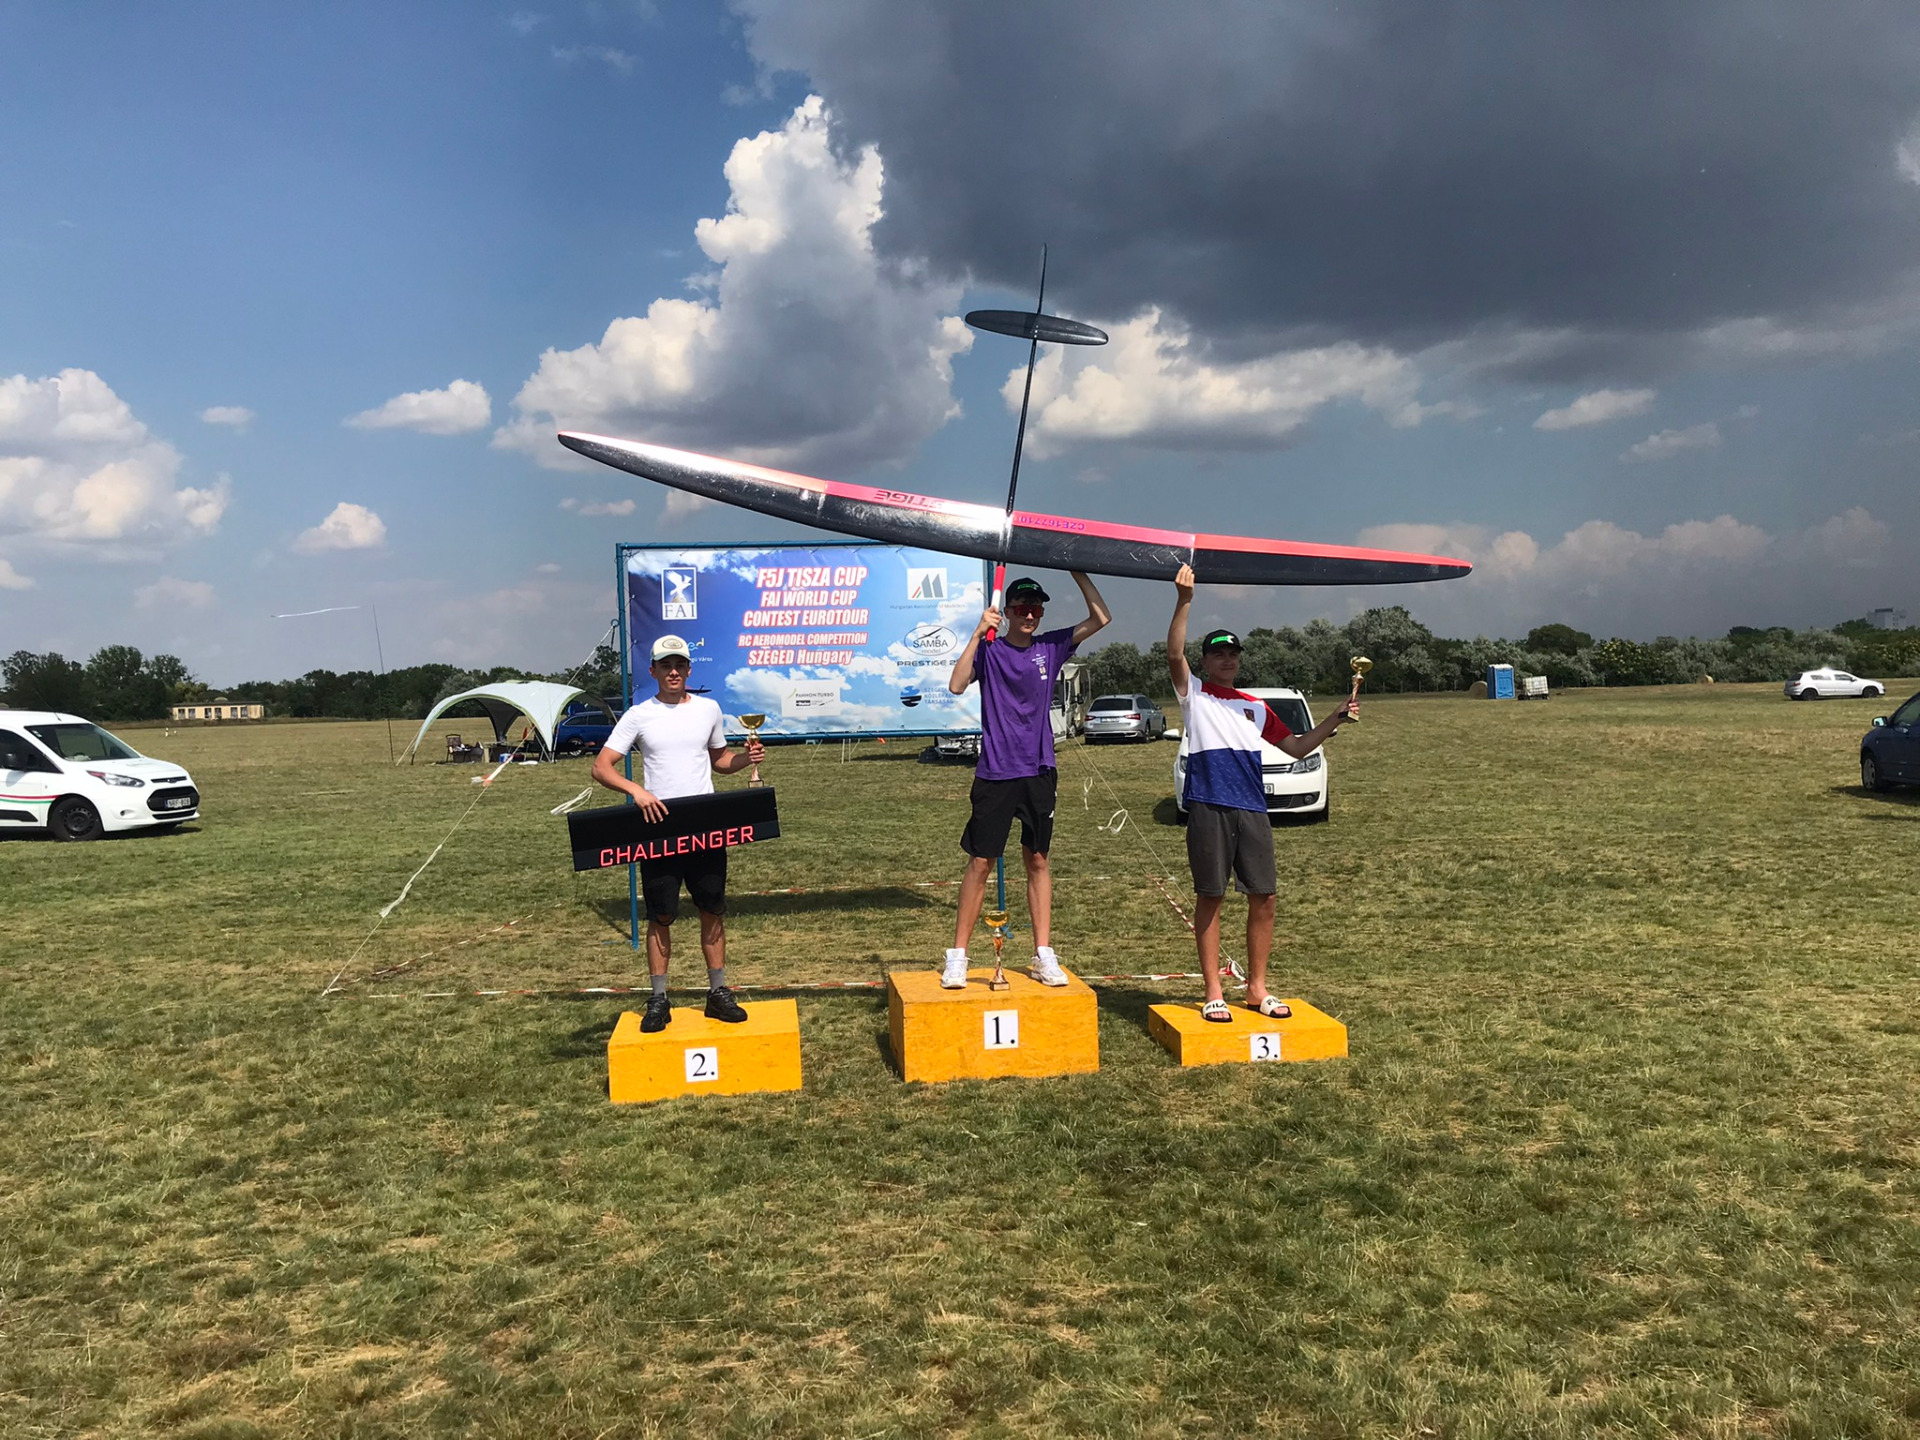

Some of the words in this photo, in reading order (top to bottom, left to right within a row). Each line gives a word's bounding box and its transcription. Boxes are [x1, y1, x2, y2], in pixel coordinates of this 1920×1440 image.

[1020, 515, 1085, 531] CZE167710
[756, 567, 785, 588] F5J
[786, 567, 831, 587] TISZA
[833, 566, 868, 587] CUP
[760, 590, 781, 607] FAI
[782, 589, 829, 607] WORLD
[830, 589, 857, 606] CUP
[664, 604, 695, 618] FAI
[743, 610, 802, 627] CONTEST
[801, 608, 869, 626] EUROTOUR
[738, 634, 753, 647] RC
[752, 633, 806, 647] AEROMODEL
[806, 632, 868, 646] COMPETITION
[912, 639, 949, 649] SAMBA
[748, 649, 796, 666] SZEGED
[796, 649, 853, 665] Hungary
[600, 825, 754, 867] CHALLENGER
[992, 1016, 1016, 1046] 1.
[1256, 1036, 1278, 1059] 3.
[692, 1053, 716, 1077] 2.
